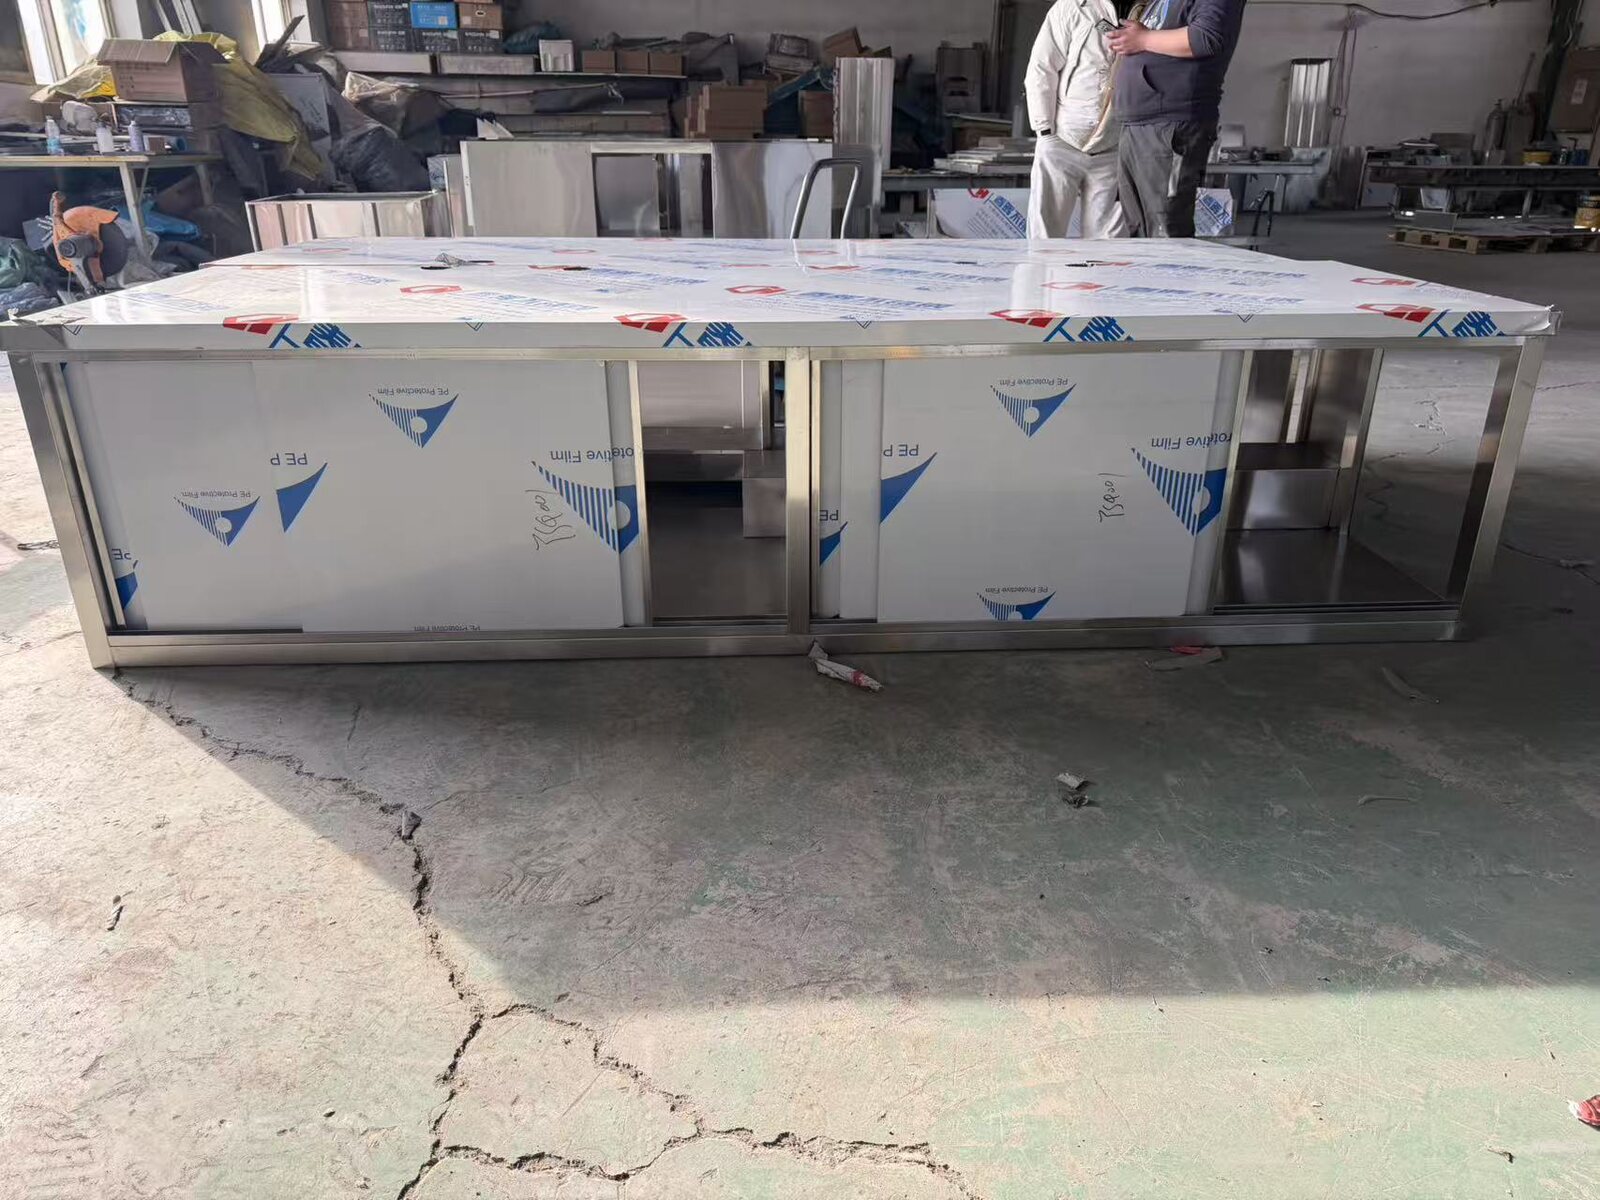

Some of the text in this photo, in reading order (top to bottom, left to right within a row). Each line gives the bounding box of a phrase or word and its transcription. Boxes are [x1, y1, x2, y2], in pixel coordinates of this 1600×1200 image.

[1000, 377, 1068, 387] PE Protective Film
[377, 387, 449, 396] PE Protective Film
[1151, 436, 1181, 450] Film
[550, 450, 582, 463] Film
[883, 444, 919, 457] PE P
[270, 452, 308, 466] PE P
[182, 490, 251, 499] PE Protective Film
[819, 509, 839, 522] PE
[1001, 586, 1036, 594] Protective
